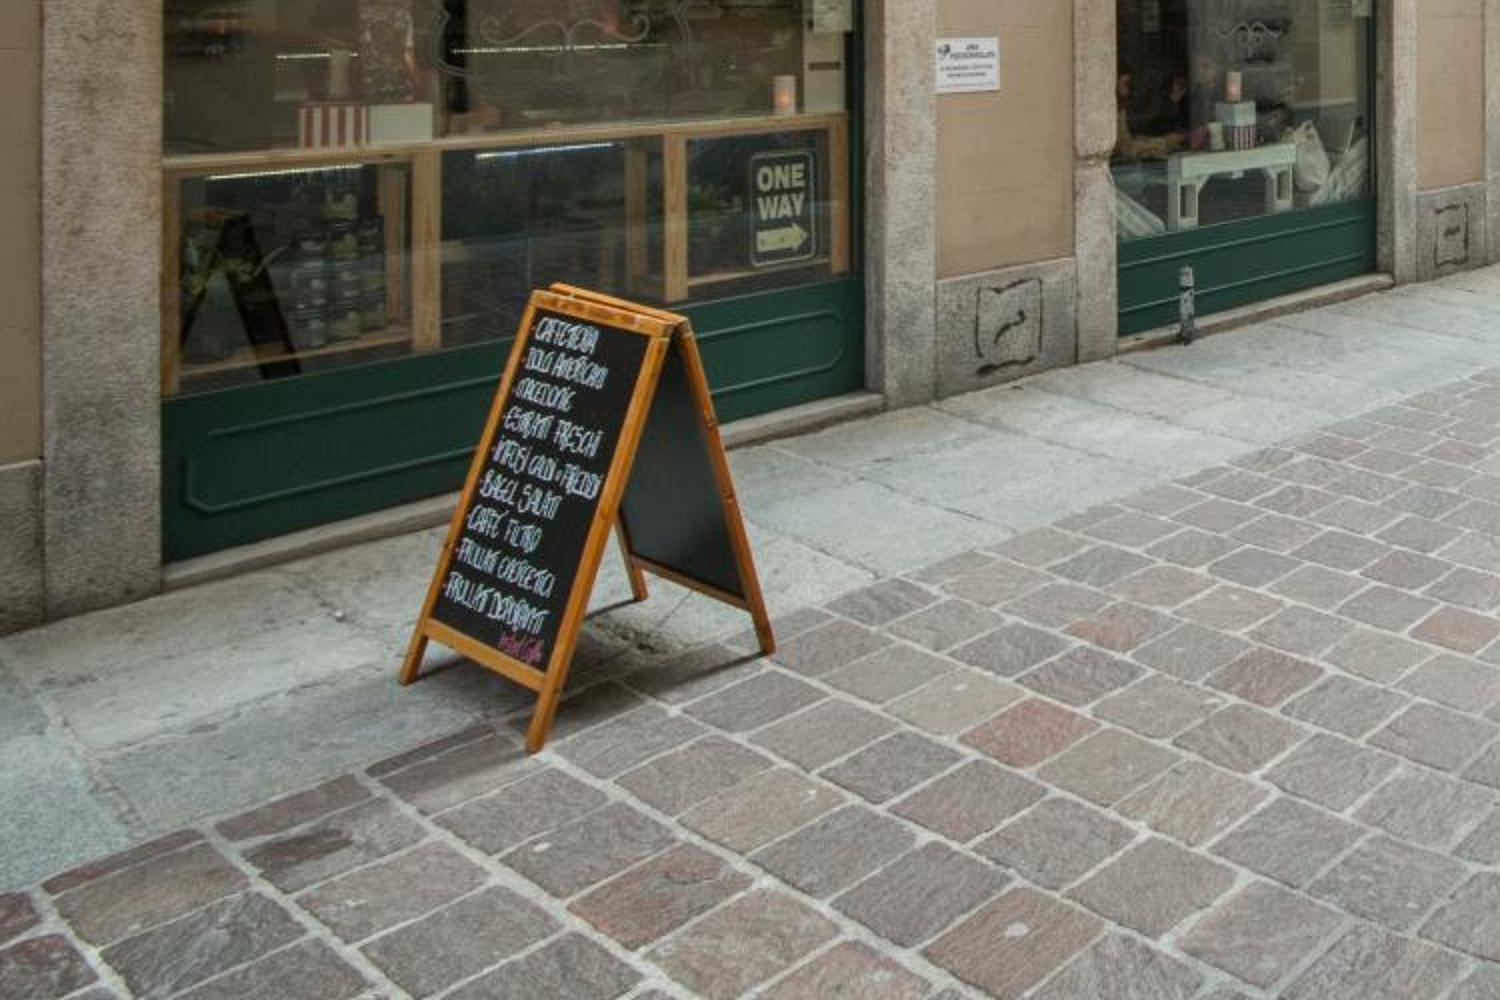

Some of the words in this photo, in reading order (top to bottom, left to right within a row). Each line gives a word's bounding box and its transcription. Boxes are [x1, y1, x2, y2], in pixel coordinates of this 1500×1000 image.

[757, 163, 805, 191] ONE
[757, 193, 804, 220] WAY
[480, 469, 518, 505] BAGEL
